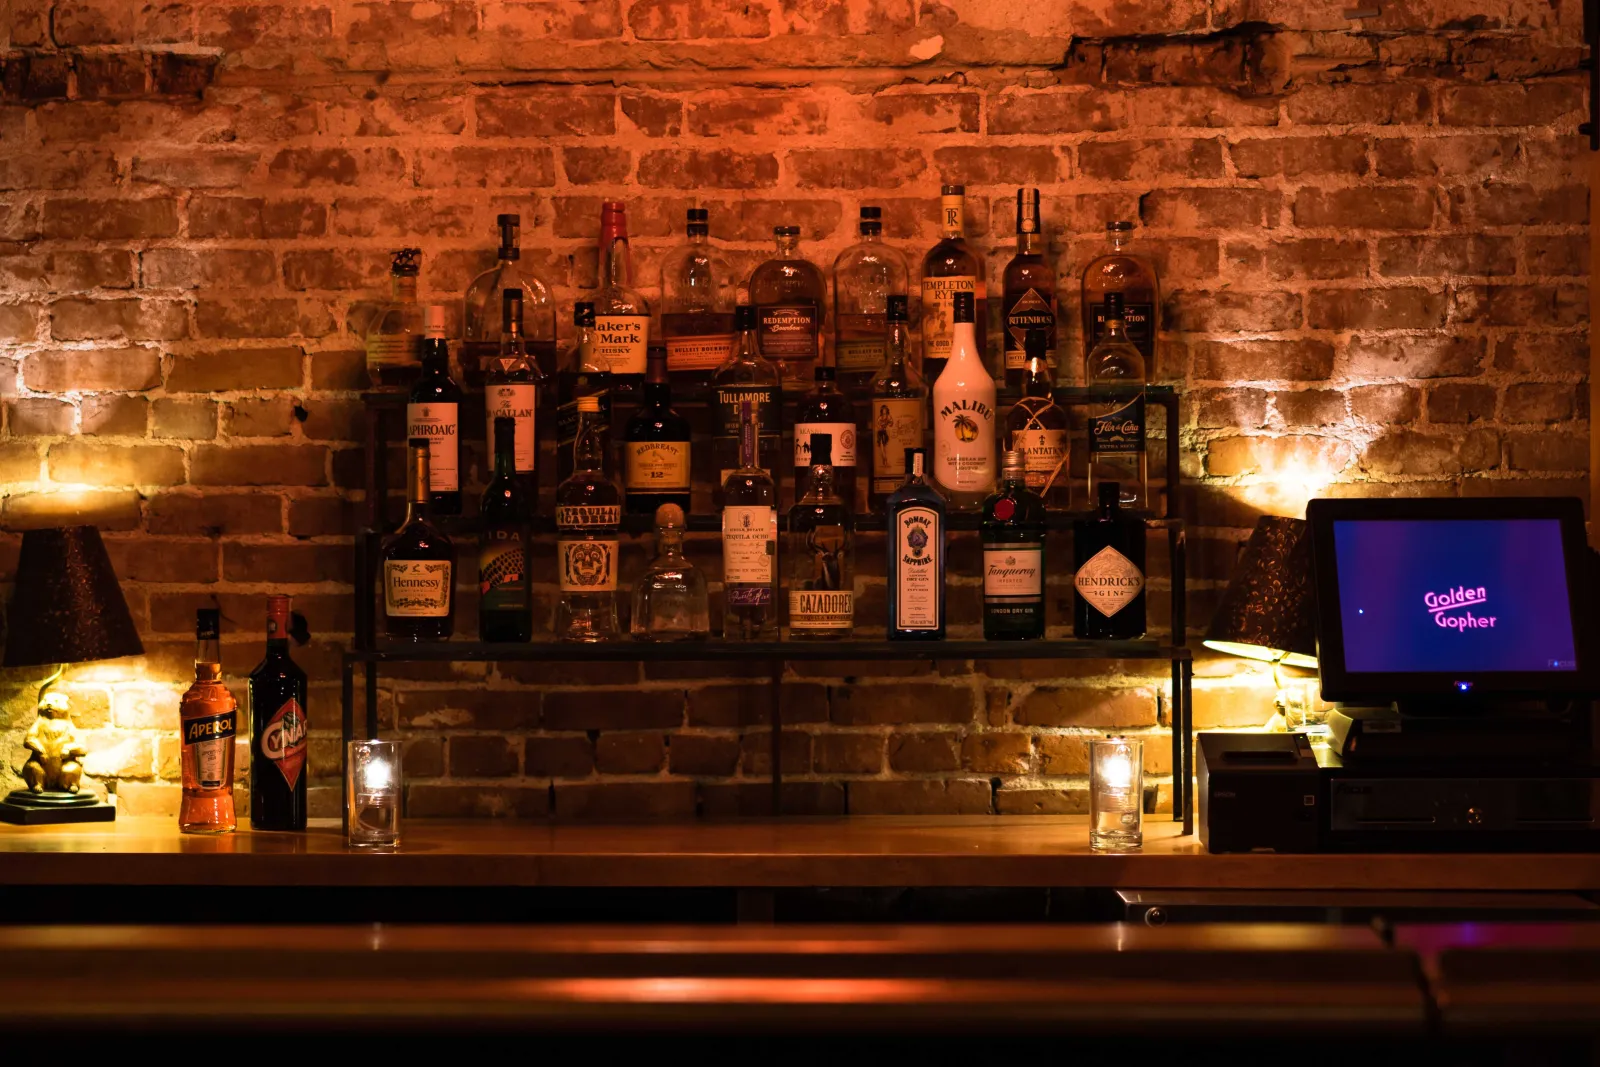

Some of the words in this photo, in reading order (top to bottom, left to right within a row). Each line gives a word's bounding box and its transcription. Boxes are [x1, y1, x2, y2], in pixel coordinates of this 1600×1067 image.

[922, 280, 974, 291] TEMPLETON
[594, 321, 641, 332] aker's
[763, 316, 811, 325] REDEMPTION
[1008, 315, 1053, 325] RITTENHOUSE
[600, 333, 641, 344] Mark
[717, 390, 771, 404] TULLAMORE
[940, 399, 994, 421] MALIBU
[1093, 419, 1116, 435] Flor
[636, 442, 679, 456] REDBREAST
[650, 471, 664, 479] 12
[564, 507, 613, 516] TEQUILA
[565, 515, 613, 524] CABEZA
[904, 515, 932, 529] BOMBAY
[902, 554, 933, 566] SAPPHIRE
[988, 565, 1036, 578] Tanqueray
[393, 576, 441, 590] Hennessy
[1078, 576, 1141, 587] HENDRICK'S
[800, 593, 852, 614] CAZADORES
[1424, 585, 1487, 609] Golden
[1434, 611, 1498, 633] Gopher
[188, 717, 233, 741] APEROL
